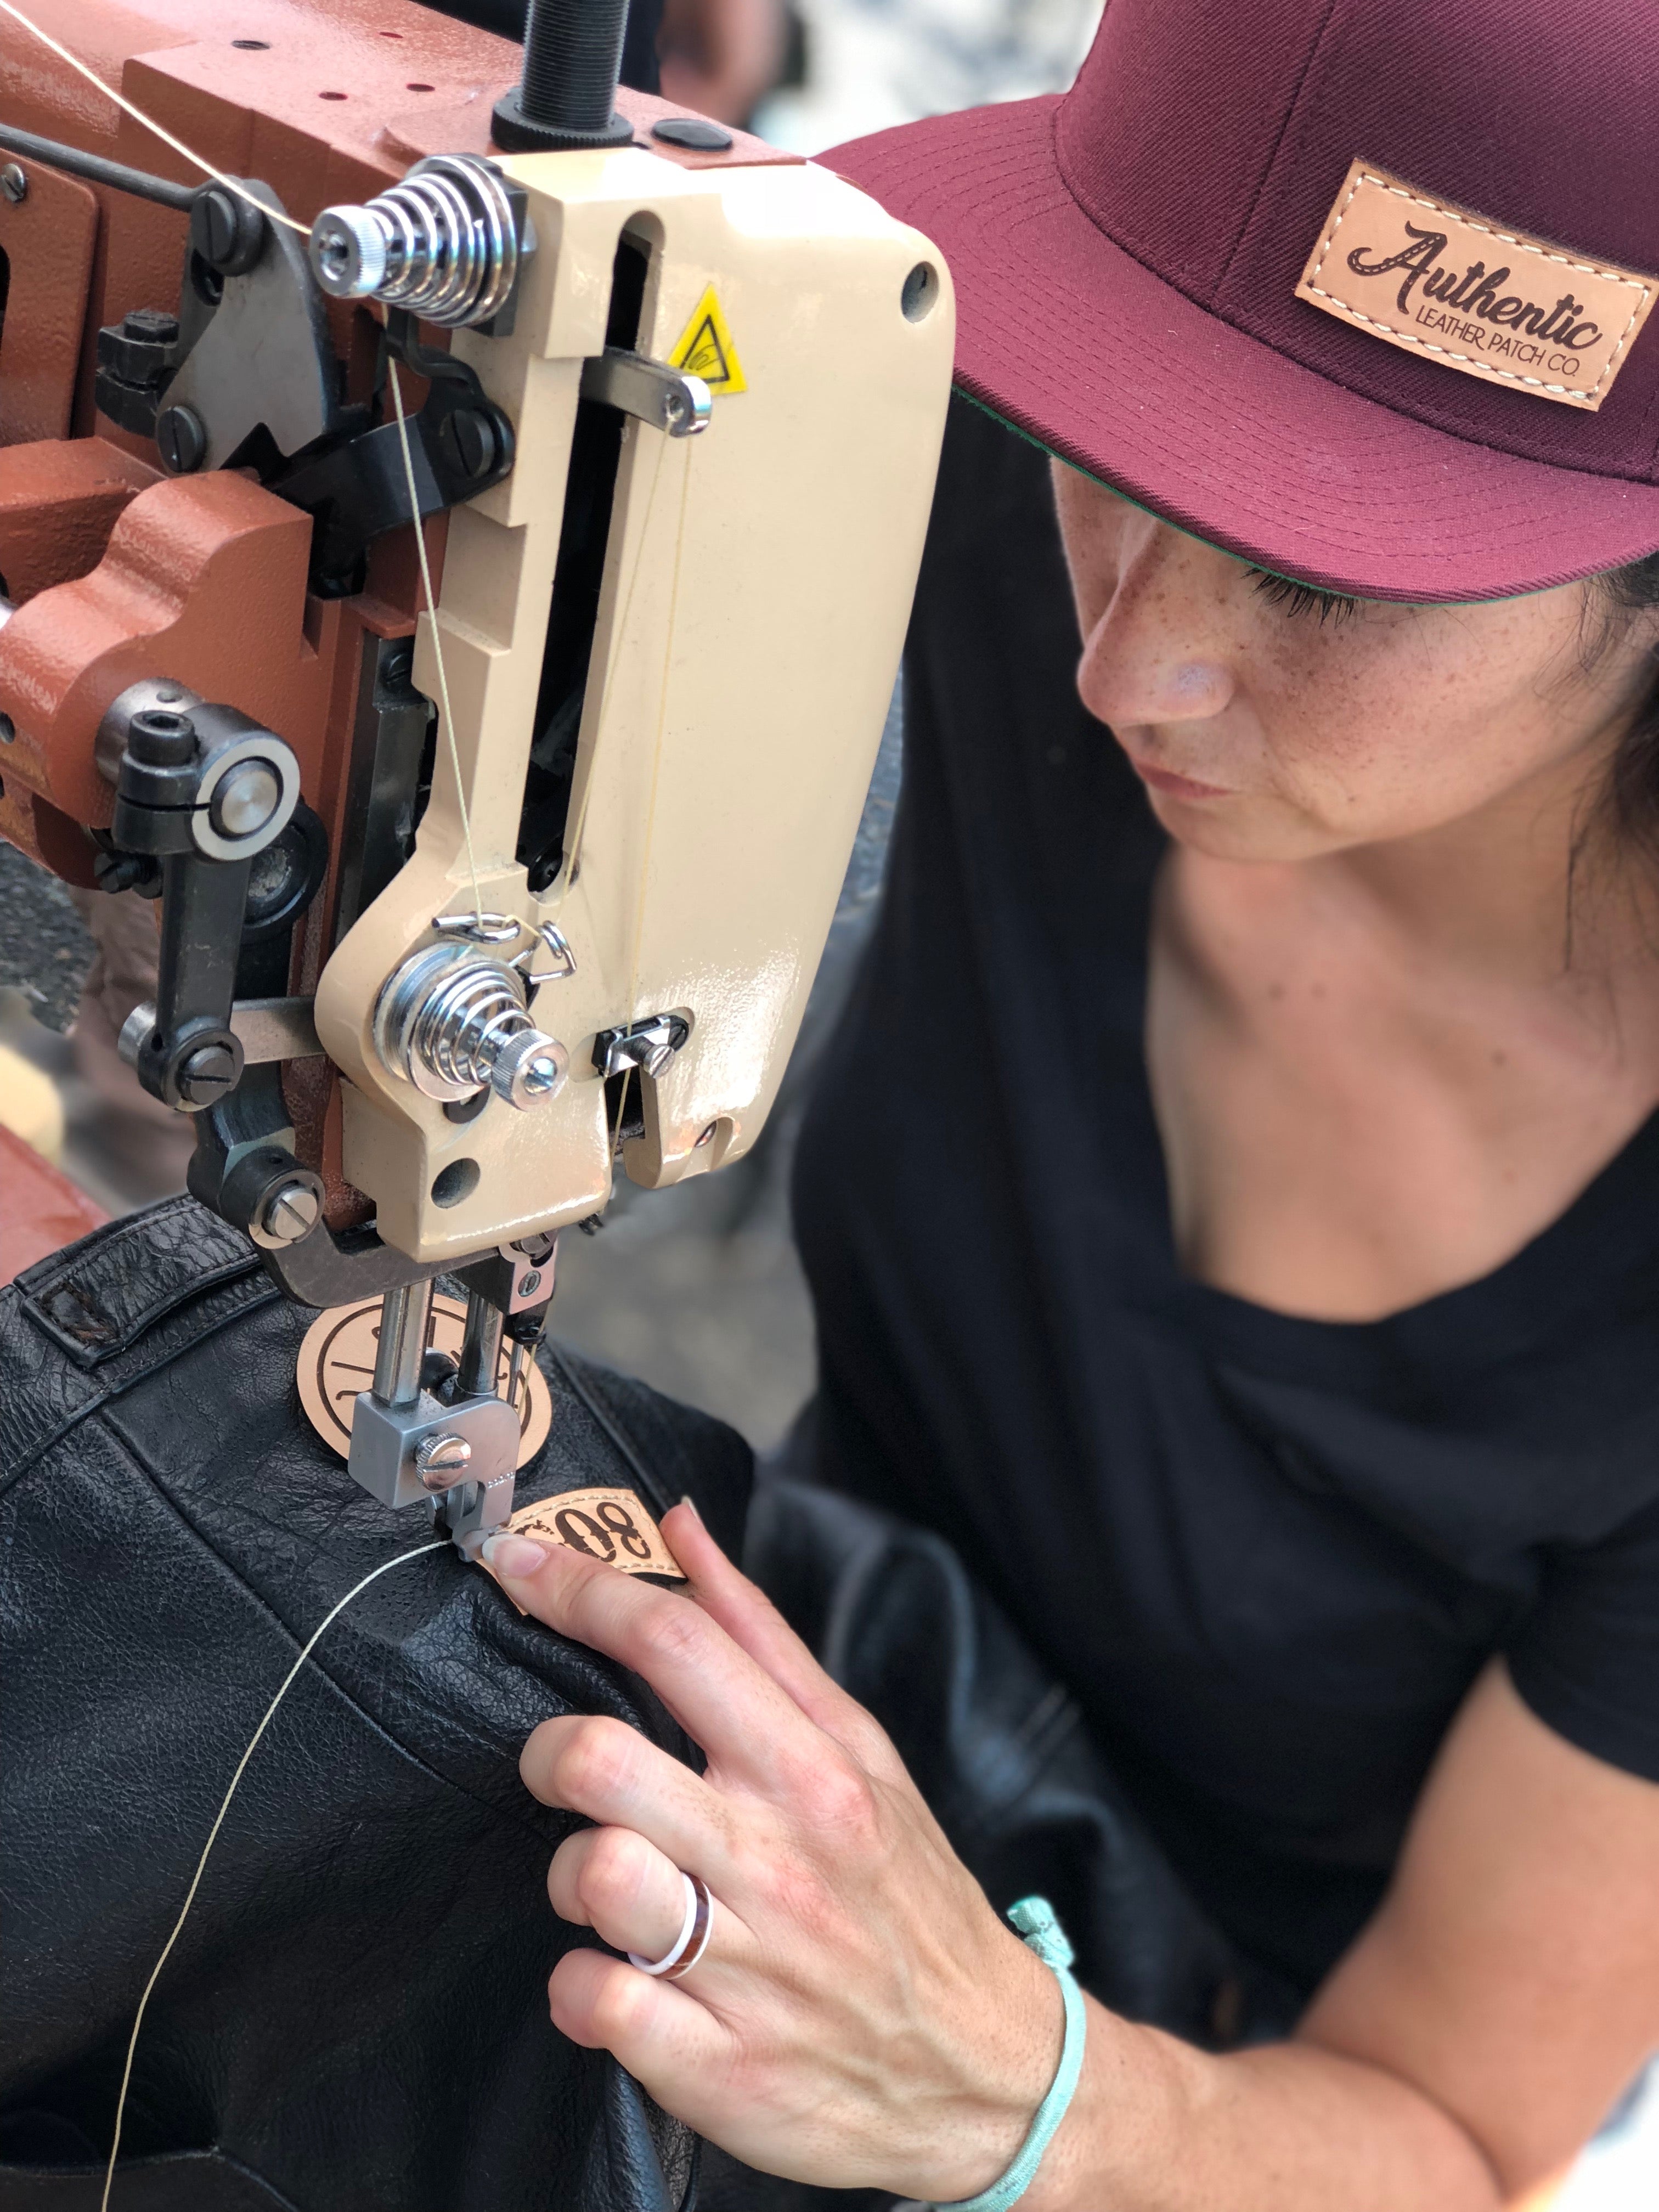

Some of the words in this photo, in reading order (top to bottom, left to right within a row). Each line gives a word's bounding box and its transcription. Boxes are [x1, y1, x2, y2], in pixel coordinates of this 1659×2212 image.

[1347, 220, 1603, 350] Authentic
[1415, 305, 1485, 351] LEATHER
[1487, 332, 1547, 366] PATCH
[1548, 353, 1581, 377] CO.
